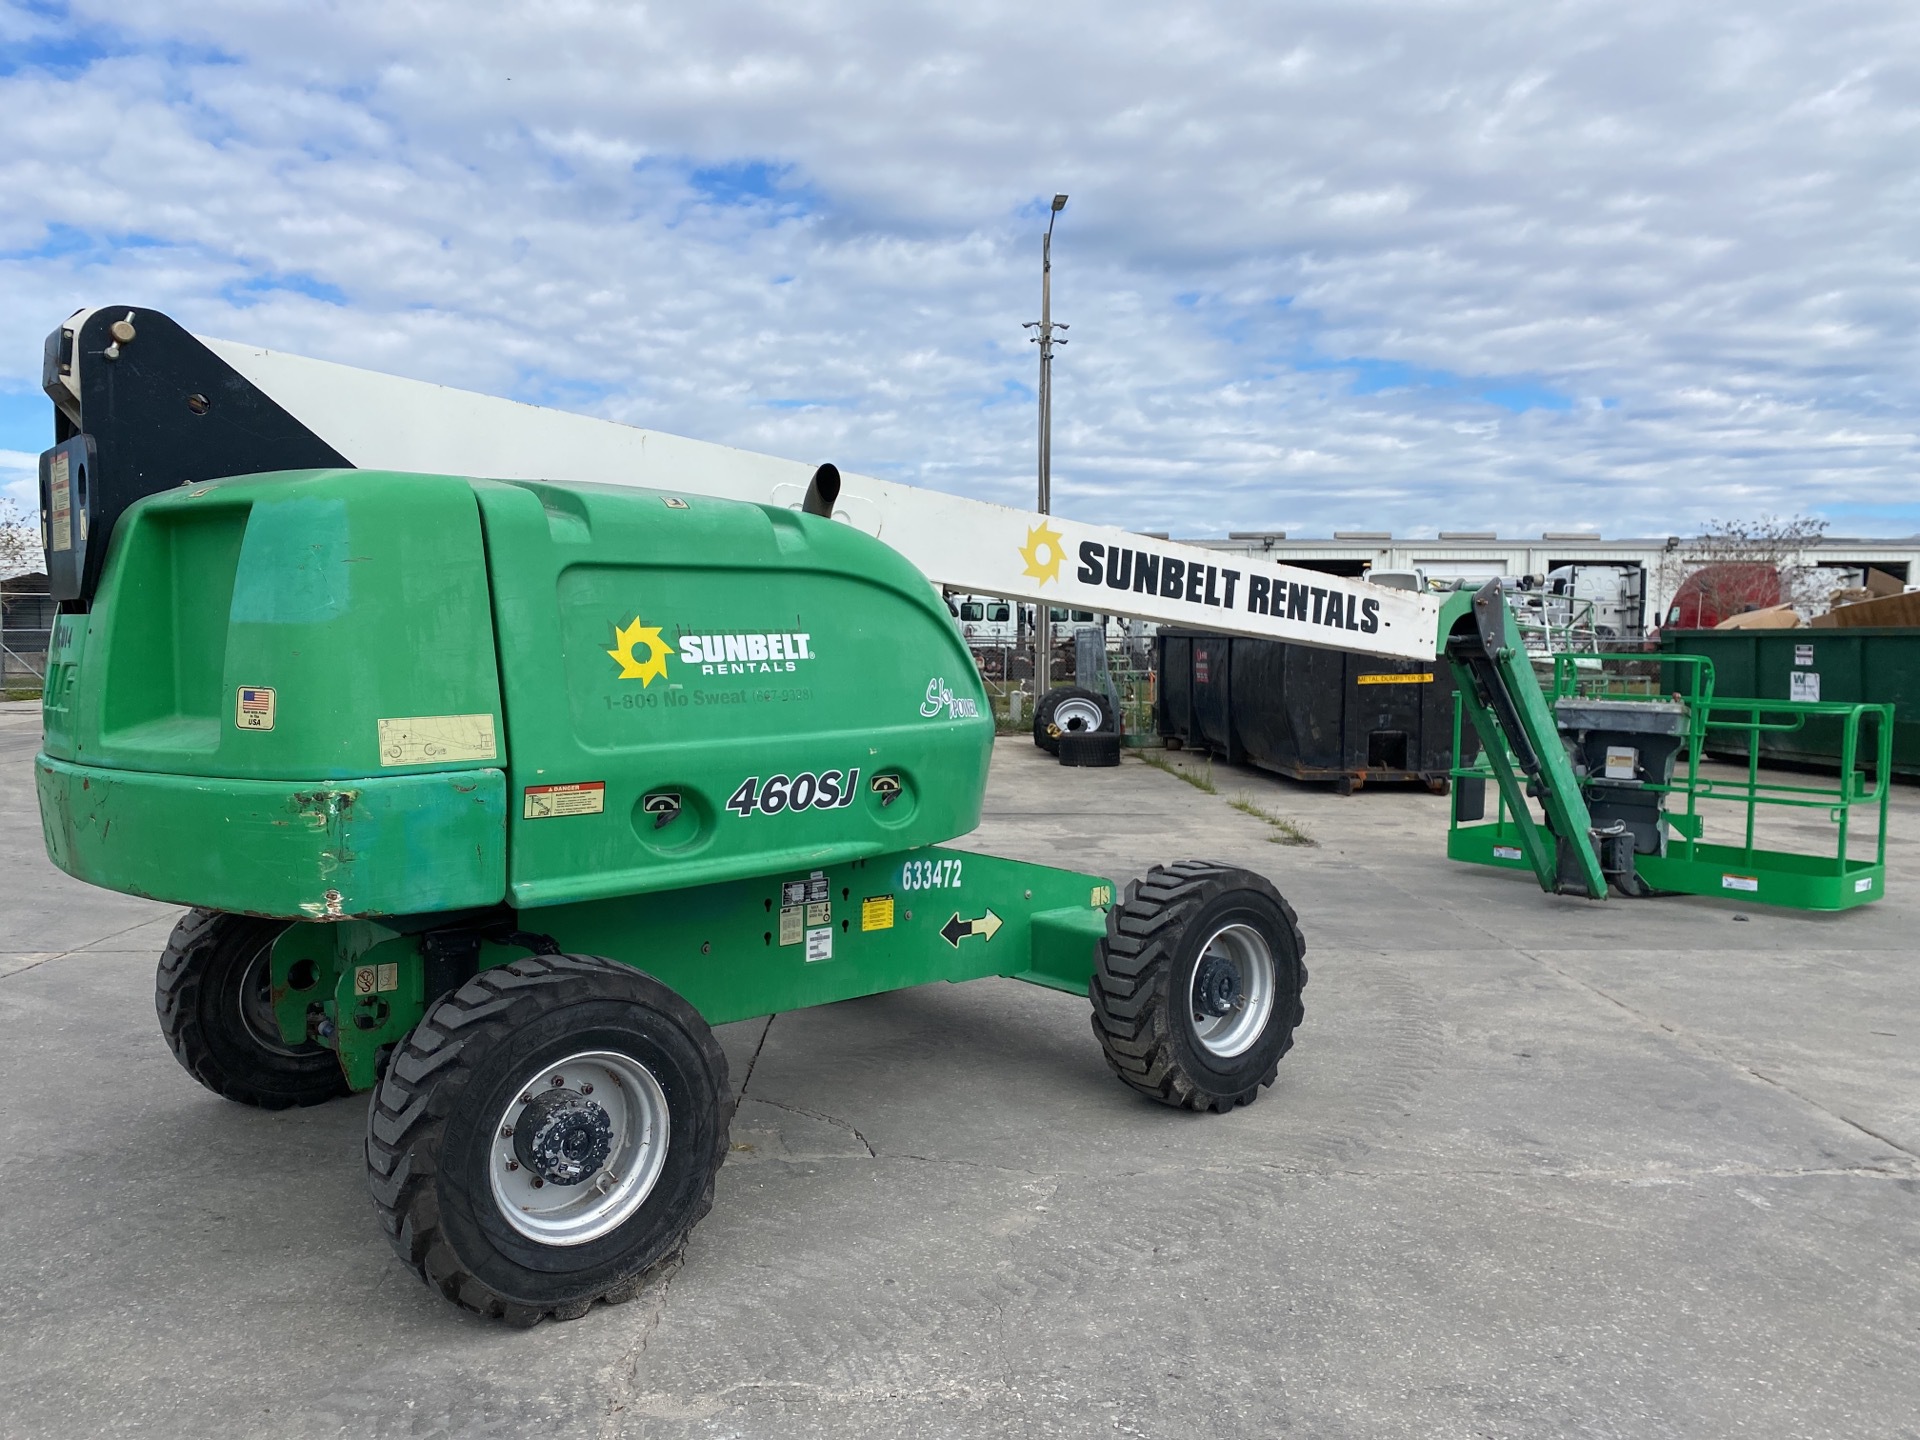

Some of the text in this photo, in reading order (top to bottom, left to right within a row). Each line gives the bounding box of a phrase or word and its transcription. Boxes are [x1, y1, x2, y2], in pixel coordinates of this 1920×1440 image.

[1077, 540, 1380, 634] SUNBELT RENTALS
[703, 661, 796, 676] RENTALS
[1381, 674, 1416, 682] DUMPSTER
[603, 692, 658, 710] 1-800
[664, 690, 689, 708] No
[693, 689, 748, 706] Sweat
[920, 677, 979, 719] Sky POWER
[725, 768, 860, 818] 460SJ
[902, 859, 962, 890] 633472
